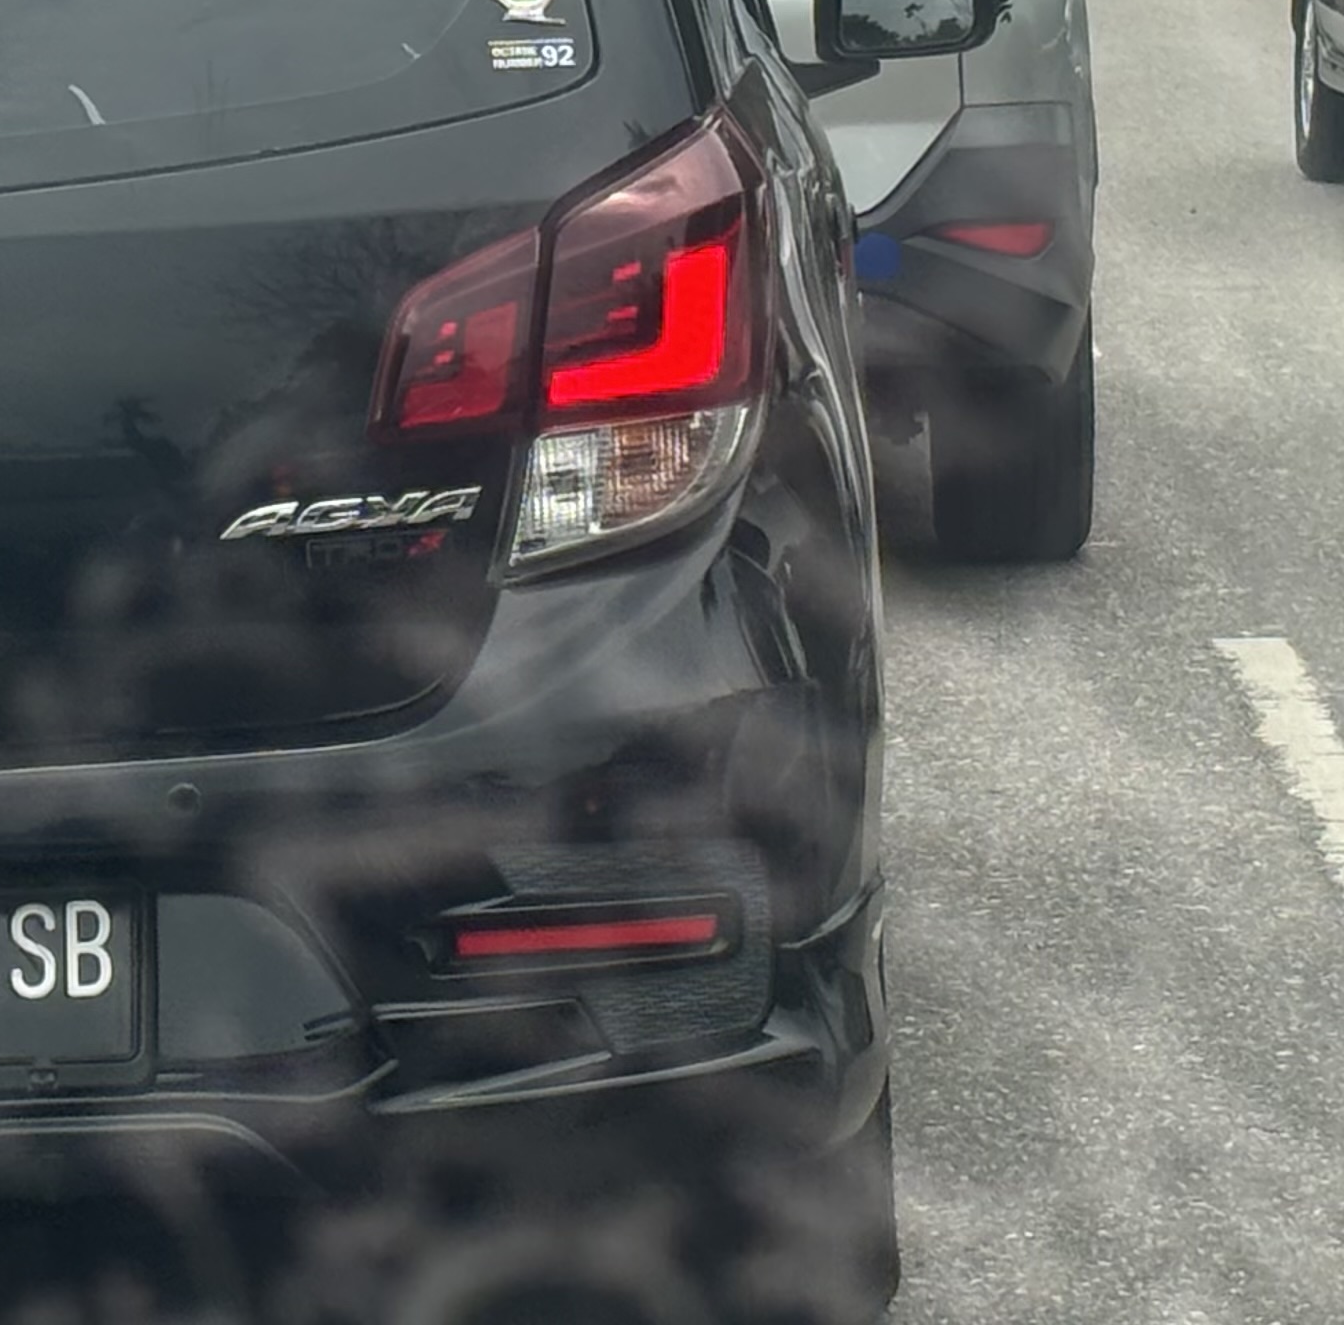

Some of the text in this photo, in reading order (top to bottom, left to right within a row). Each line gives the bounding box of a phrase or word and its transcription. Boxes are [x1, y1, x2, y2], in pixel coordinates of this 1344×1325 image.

[541, 44, 576, 67] 92
[219, 486, 483, 540] AGYA
[9, 899, 114, 1000] SB
